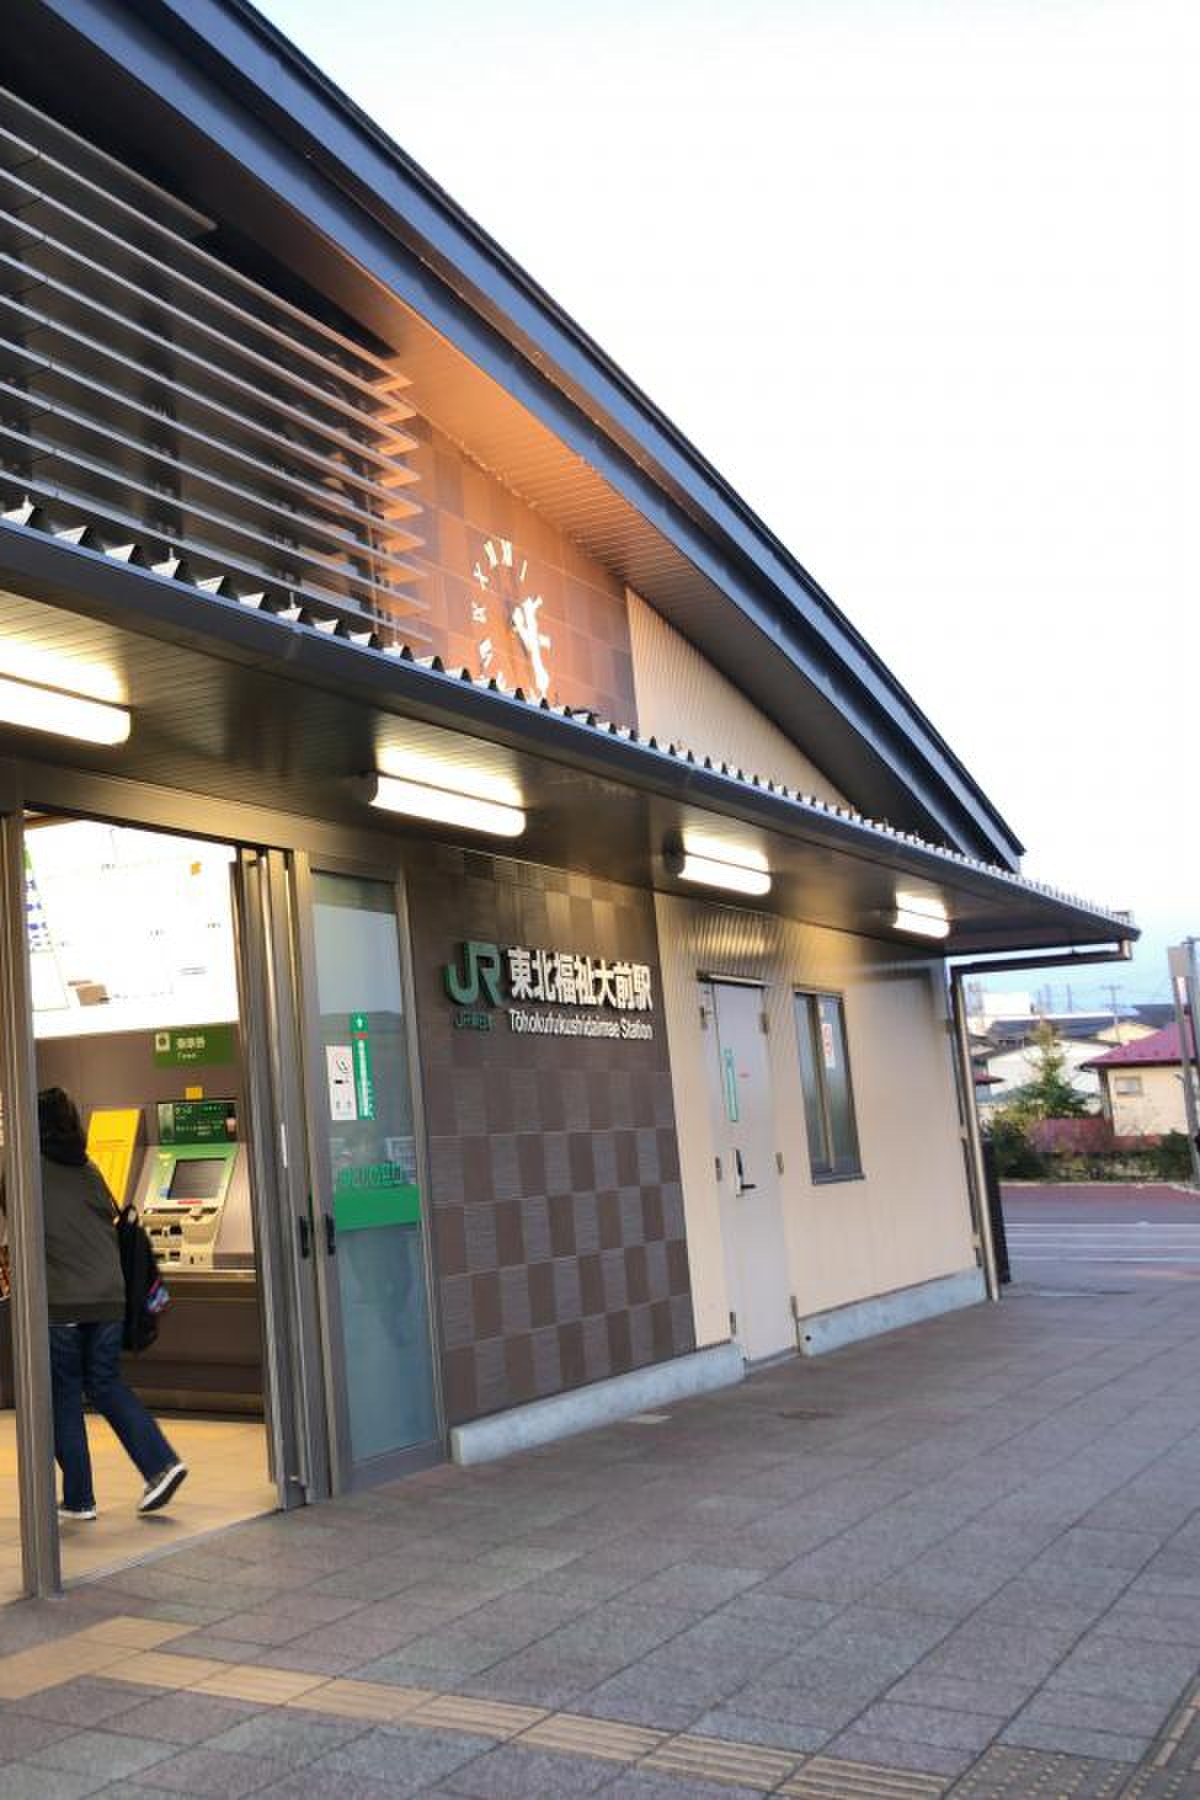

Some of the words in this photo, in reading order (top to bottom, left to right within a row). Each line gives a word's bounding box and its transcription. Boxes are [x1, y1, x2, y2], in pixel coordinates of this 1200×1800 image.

[447, 941, 503, 1008] JR
[508, 946, 653, 1011] 東北福祉大前駅
[621, 1017, 653, 1040] Station
